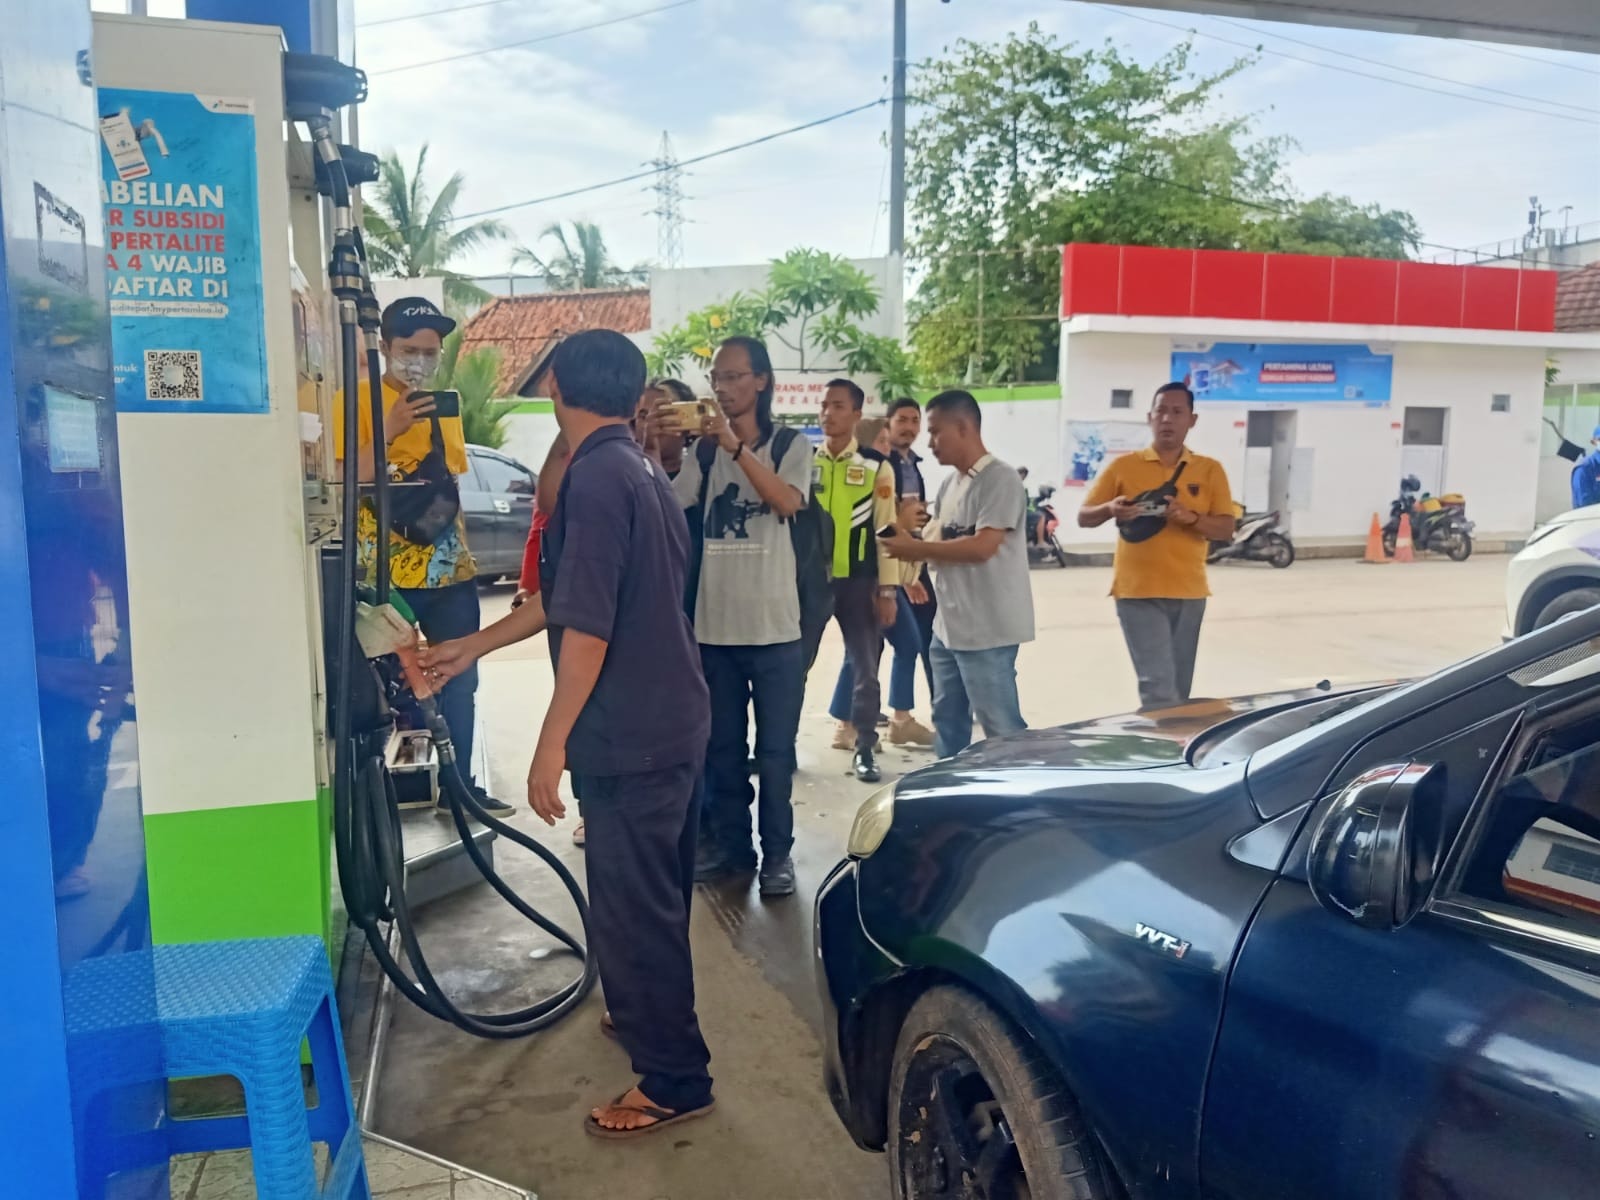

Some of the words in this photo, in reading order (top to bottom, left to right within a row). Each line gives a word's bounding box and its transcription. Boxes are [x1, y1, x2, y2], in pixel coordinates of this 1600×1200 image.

[104, 208, 123, 226] R
[133, 209, 225, 229] SUBSIDI
[110, 231, 225, 252] PERTALITE
[127, 254, 142, 271] 4
[149, 254, 227, 274] WAJIB
[108, 276, 194, 297] AFTAR
[203, 278, 228, 298] DI
